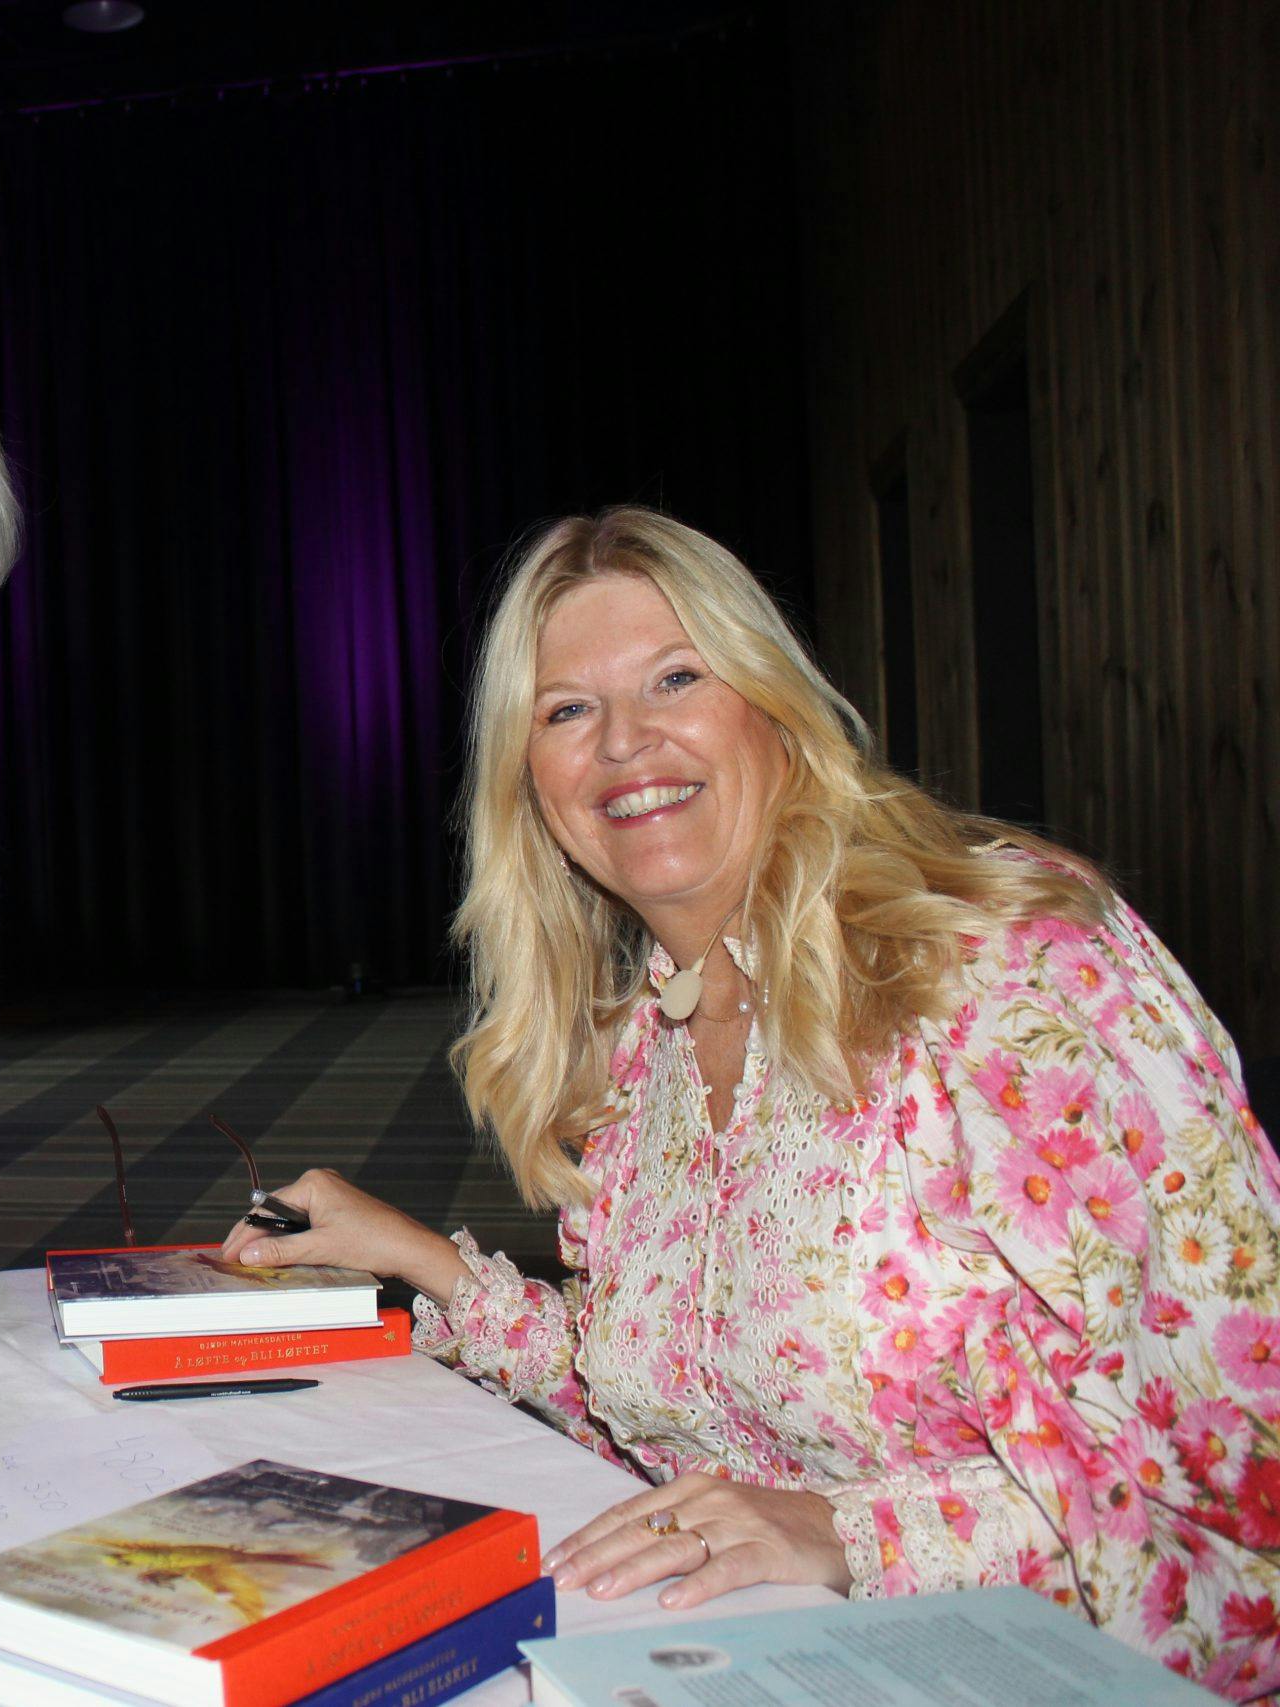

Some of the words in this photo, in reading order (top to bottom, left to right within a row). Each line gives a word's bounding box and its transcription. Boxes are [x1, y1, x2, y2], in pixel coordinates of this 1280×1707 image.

[230, 1333, 302, 1347] MATHEASDATTER
[187, 1354, 230, 1368] LØFTE
[234, 1355, 248, 1367] og
[250, 1350, 274, 1362] BLI
[277, 1344, 329, 1359] LØFTET
